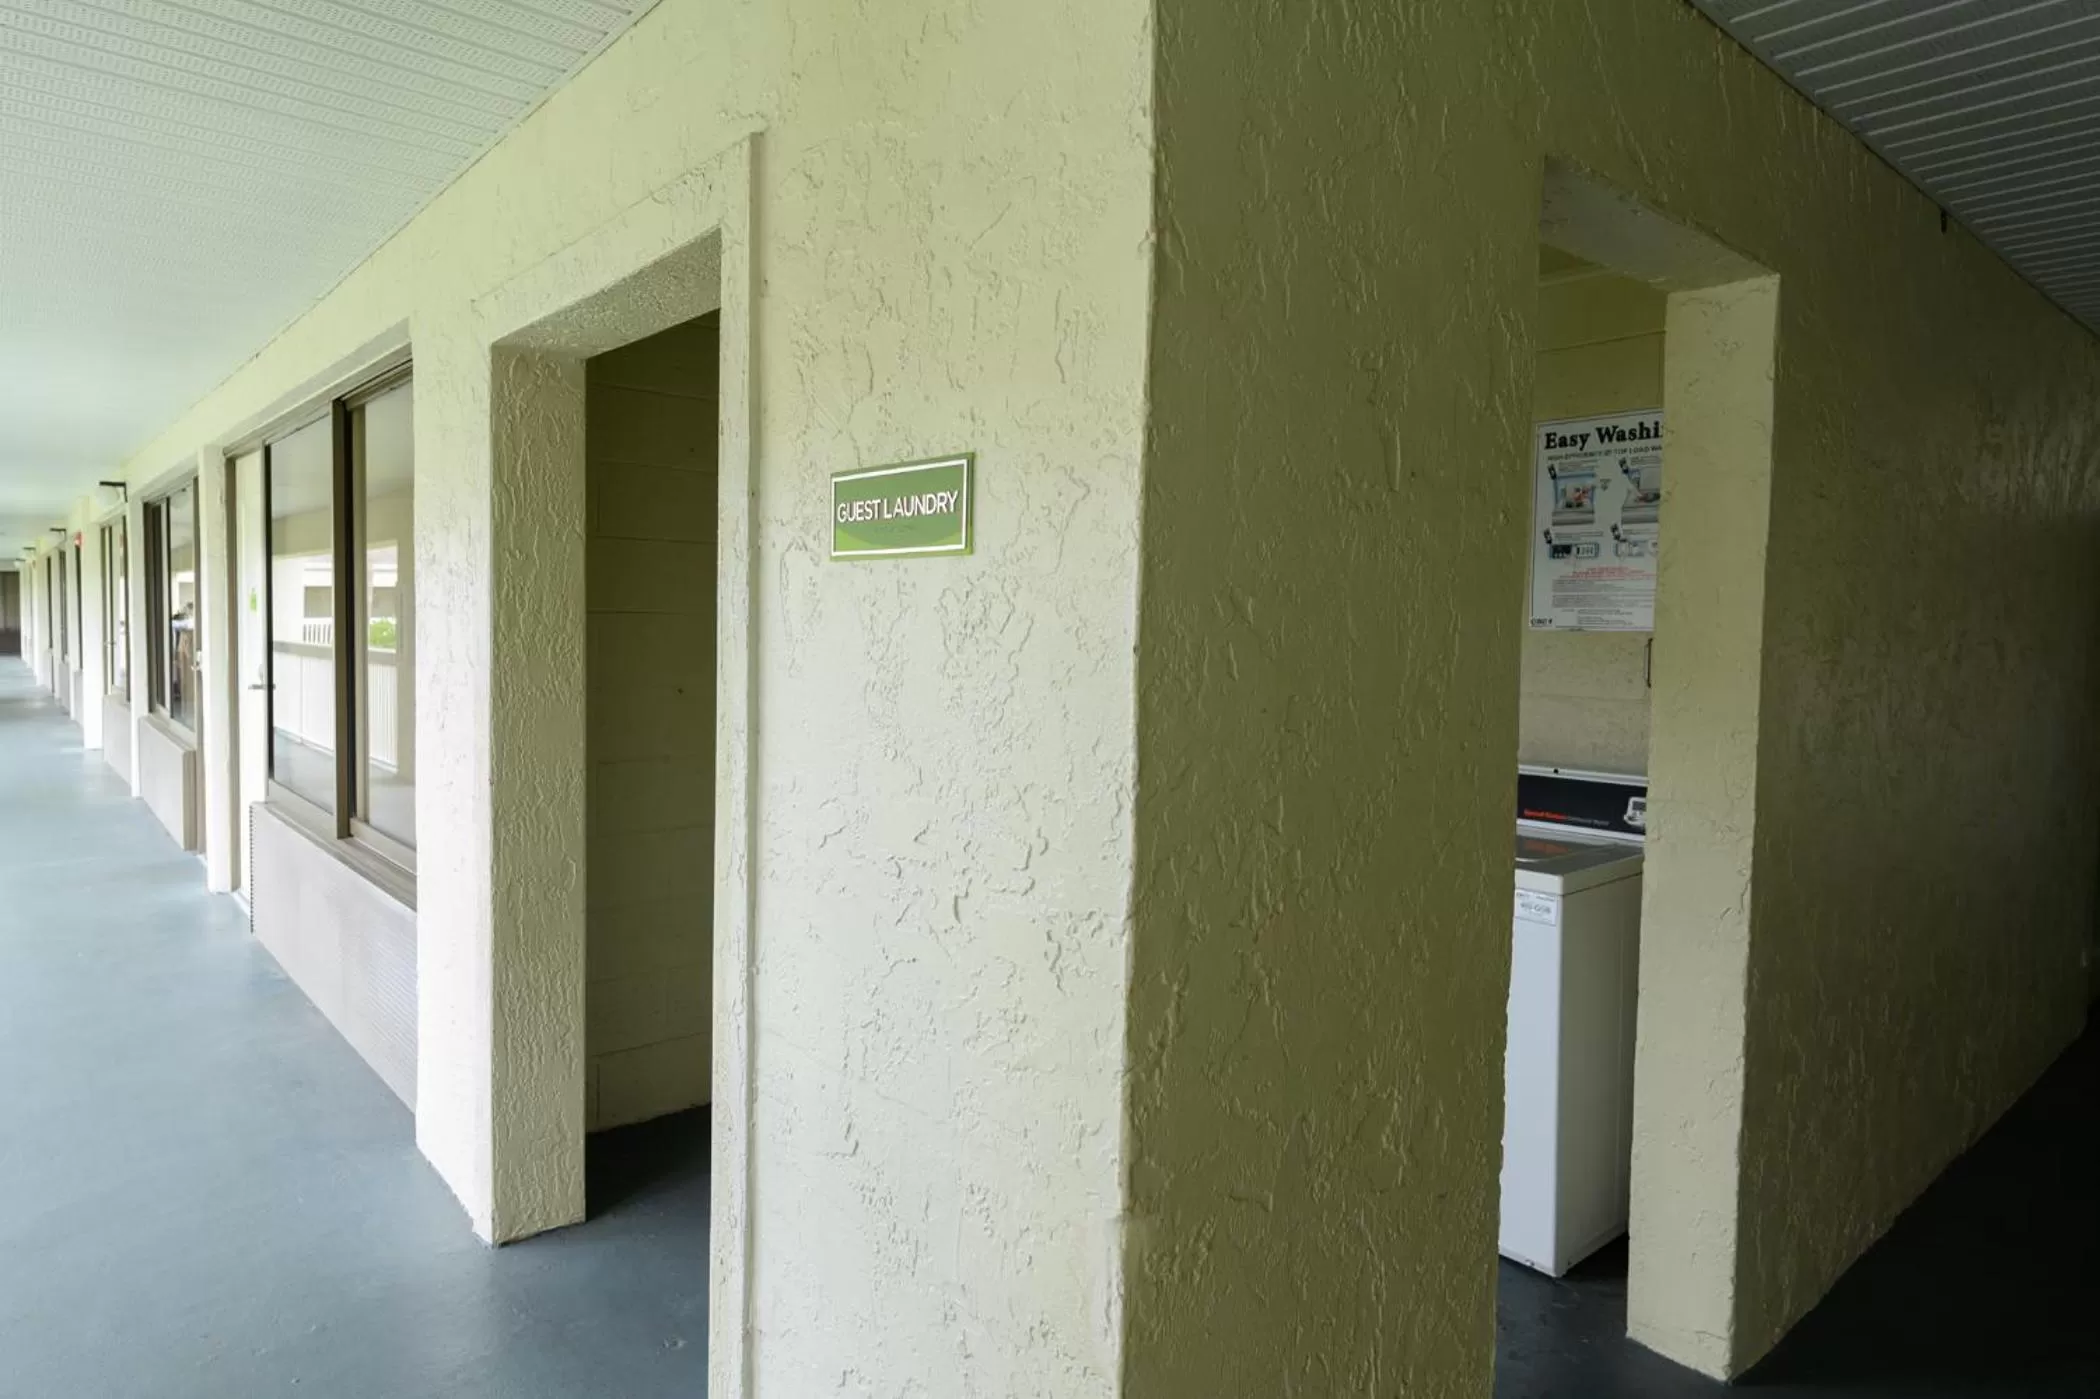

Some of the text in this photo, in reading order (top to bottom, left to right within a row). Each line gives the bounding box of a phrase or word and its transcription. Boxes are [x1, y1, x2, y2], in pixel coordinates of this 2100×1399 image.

[1544, 420, 1663, 452] Easy Washi
[837, 490, 959, 523] GUEST LAUNDRY
